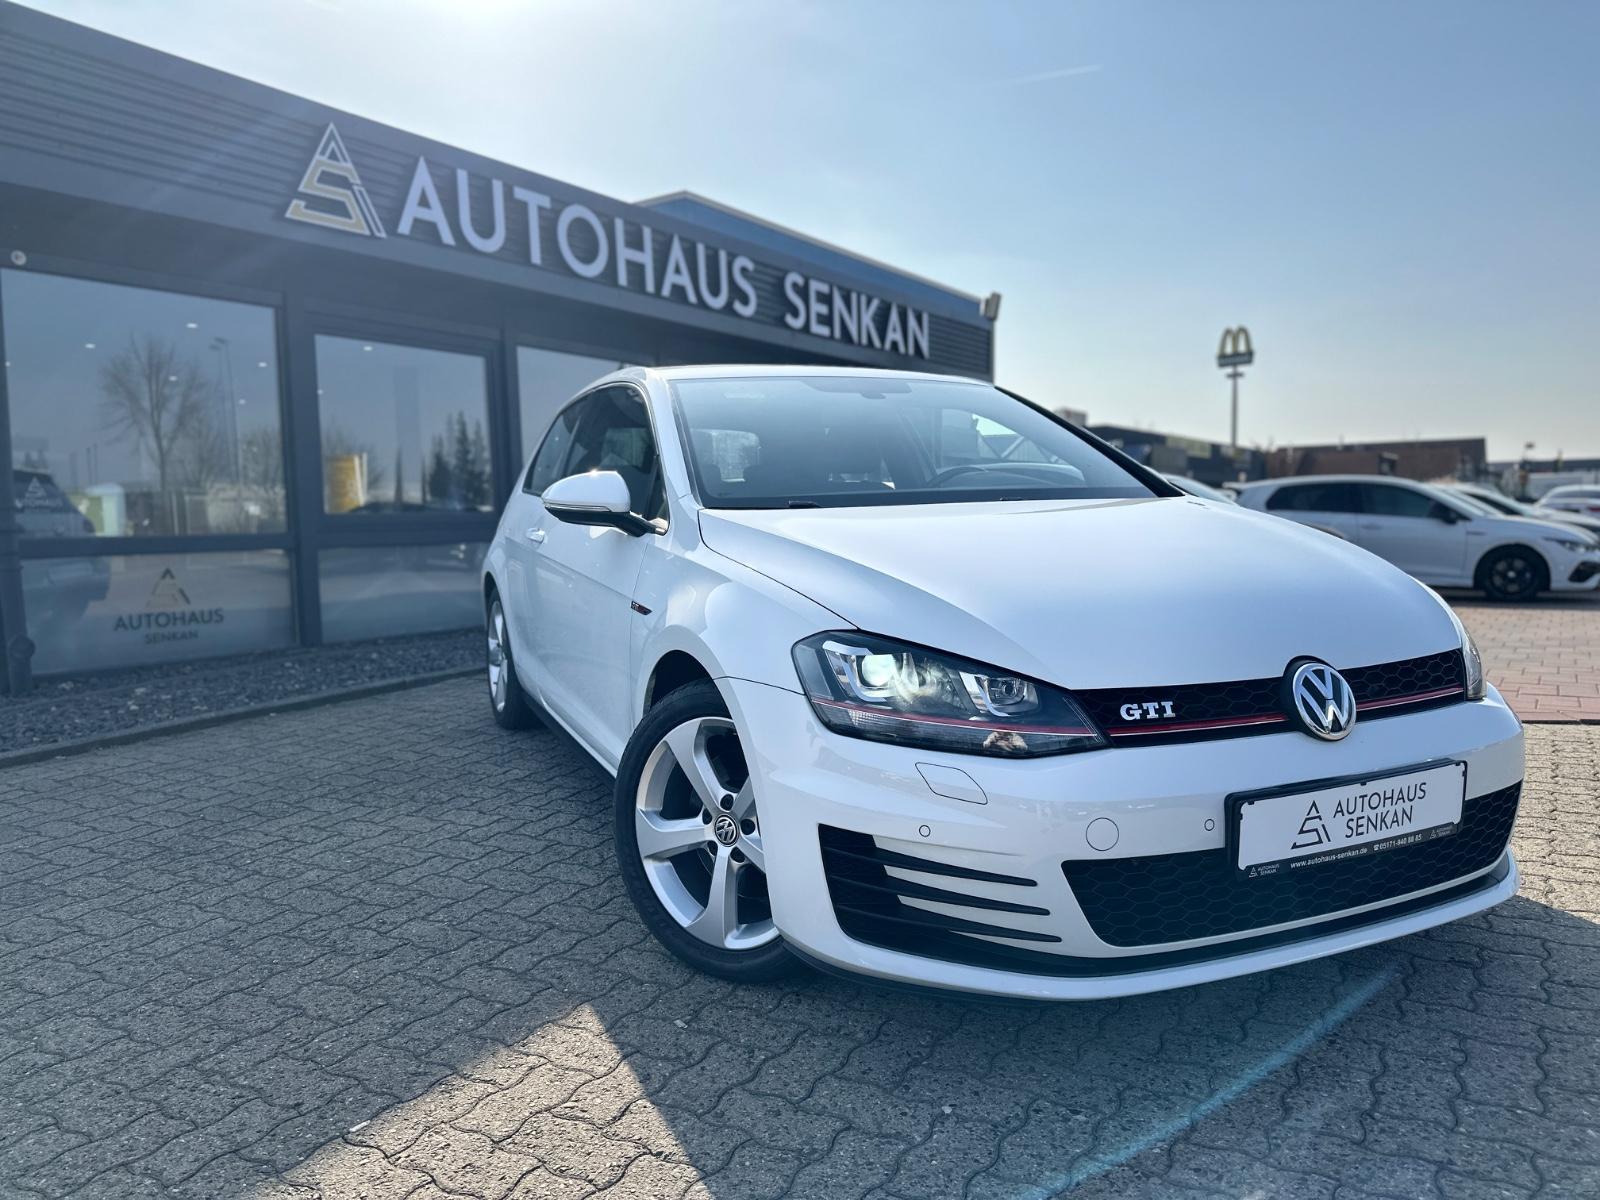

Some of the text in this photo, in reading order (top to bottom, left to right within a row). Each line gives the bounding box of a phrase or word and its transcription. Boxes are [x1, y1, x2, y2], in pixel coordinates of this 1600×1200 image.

[397, 155, 930, 360] AUTOHAUS SENKAN
[113, 608, 225, 632] AUTOHAUS
[144, 629, 200, 645] SENKAN
[1119, 701, 1176, 721] GTI
[1333, 782, 1427, 819] AUTOHAUS
[1345, 806, 1413, 839] SENKAN
